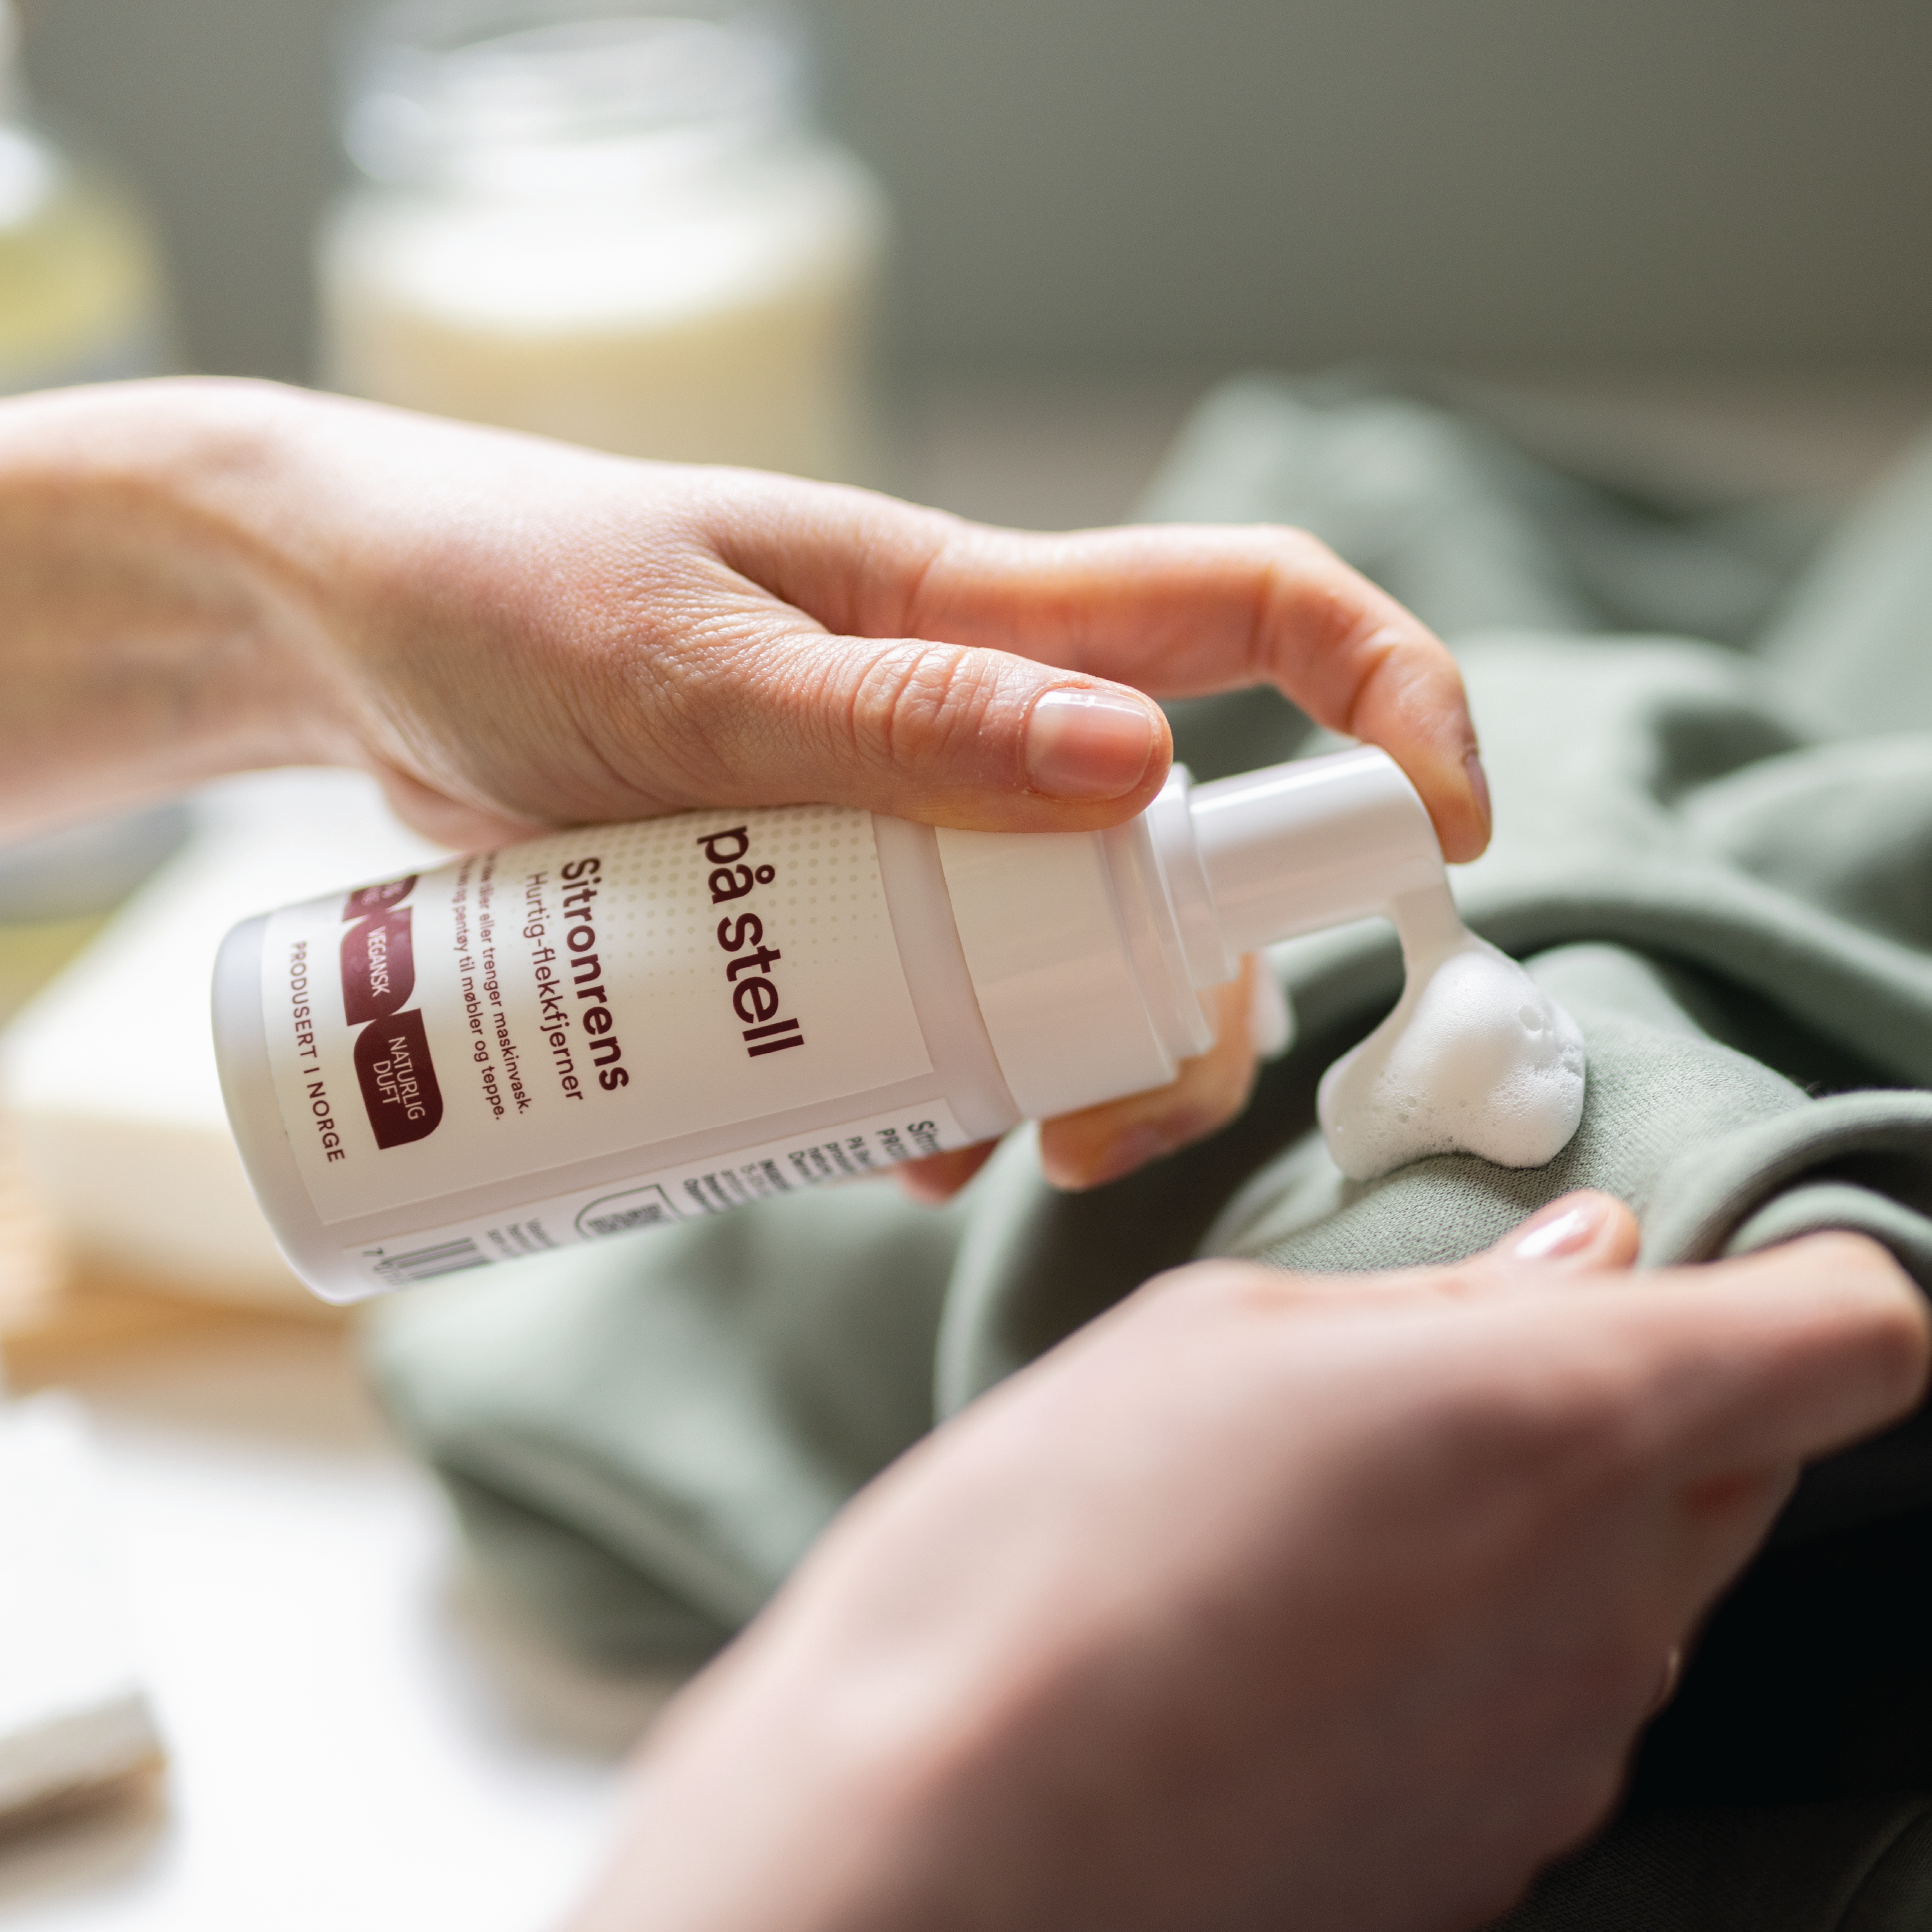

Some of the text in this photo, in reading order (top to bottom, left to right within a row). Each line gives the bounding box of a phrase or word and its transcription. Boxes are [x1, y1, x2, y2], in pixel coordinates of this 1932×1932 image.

[696, 825, 776, 905] på
[453, 905, 469, 952] pentøy
[479, 913, 494, 943] eller
[368, 926, 390, 997] VEGANSK
[459, 956, 475, 972] til
[482, 947, 502, 1007] trenger
[523, 870, 583, 1101] Hurtig-flekkfjerner
[560, 857, 629, 1091] Sitronrens
[717, 913, 805, 1058] stell
[462, 976, 484, 1035] møbler
[290, 941, 317, 1057] PRODUSERT
[307, 1081, 345, 1162] NORGE
[373, 1060, 401, 1104] DUFT
[388, 1036, 426, 1121] NATURLIG
[473, 1040, 489, 1063] og
[493, 1012, 532, 1114] maskinvask.
[481, 1065, 505, 1121] teppe.
